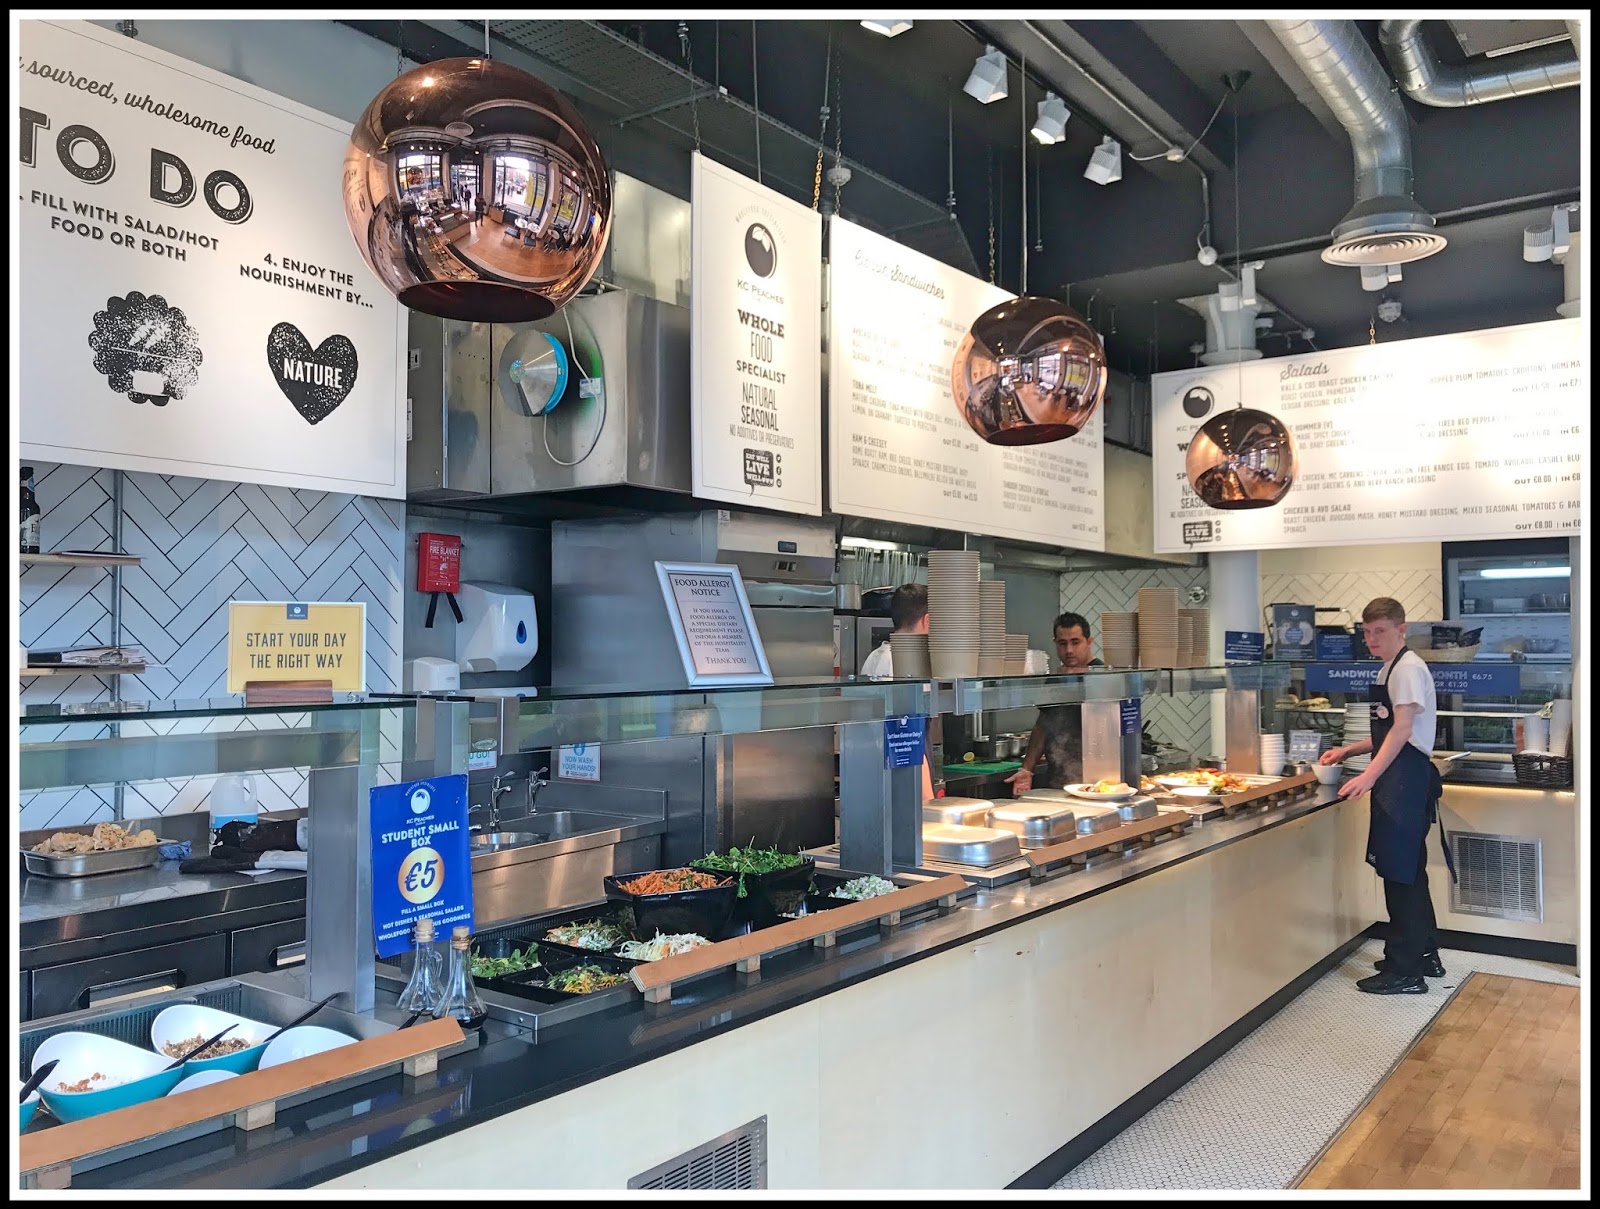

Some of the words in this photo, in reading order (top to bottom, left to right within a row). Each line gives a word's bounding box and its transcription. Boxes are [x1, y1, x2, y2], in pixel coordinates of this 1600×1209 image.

[26, 57, 118, 103] sourced,
[124, 89, 230, 139] wholesome
[230, 125, 276, 154] food
[150, 147, 254, 225] DO
[31, 190, 67, 212] FILL
[73, 201, 118, 225] WITH
[124, 214, 219, 252] SALAD/HOT
[51, 216, 104, 242] FOOD
[110, 230, 135, 248] OR
[141, 238, 187, 262] BOTH
[263, 252, 278, 267] 4.
[282, 257, 325, 279] ENJOY
[329, 268, 354, 286] THE
[239, 264, 342, 302] NOURISHMENT
[346, 292, 374, 308] BY...
[737, 279, 749, 291] KC
[891, 264, 945, 299] Sandwiches
[737, 309, 785, 338] WHOLE
[751, 331, 772, 363] FOOD
[283, 357, 343, 389] NATURE
[736, 360, 786, 384] SPECIALIST
[1280, 362, 1329, 382] Salads
[1319, 379, 1338, 388] ROAST
[1340, 376, 1367, 386] CHICKEN
[1456, 373, 1473, 382] PLUM
[742, 381, 778, 411] NATURAL
[741, 405, 779, 431] SEASONAL
[1458, 418, 1470, 426] RED
[1439, 428, 1469, 438] DRESSING
[746, 460, 770, 475] LIVE
[1434, 463, 1454, 472] RANGE
[1354, 480, 1366, 488] AND
[1407, 475, 1437, 484] DRESSING
[1283, 506, 1310, 515] CHICKEN
[1318, 505, 1329, 513] AVO
[1331, 504, 1352, 512] SALAD
[1378, 511, 1397, 519] HONEY
[1400, 509, 1428, 518] MUSTARD
[1463, 505, 1483, 514] MIXED
[1486, 503, 1519, 513] SEASONAL
[1522, 501, 1556, 511] TOMATOES
[1284, 526, 1307, 534] SPINACH
[1534, 520, 1553, 529] €8.00
[1562, 520, 1572, 528] IN
[1185, 529, 1209, 537] LIVE
[430, 546, 439, 554] FIRE
[440, 547, 459, 556] BLANKET
[675, 579, 698, 587] FOOD
[700, 580, 730, 588] ALLERGY
[247, 633, 284, 647] START
[290, 633, 318, 647] YOUR
[325, 633, 347, 647] DAY
[250, 654, 271, 668] THE
[277, 654, 310, 668] RIGHT
[316, 654, 343, 668] WAY
[1328, 670, 1378, 679] SANDWIC
[414, 815, 435, 823] PEACHES
[382, 826, 426, 844] STUDENT
[429, 821, 459, 835] SMALL
[411, 836, 432, 848] BOX
[405, 859, 438, 892] €5
[417, 903, 433, 911] SMALL
[383, 922, 394, 930] HOT
[395, 918, 413, 927] DISHES
[418, 910, 444, 920] SEASONAL
[445, 905, 464, 914] SALADS
[378, 928, 411, 941] WHOLEFOOD
[442, 913, 471, 924] GOODNESS
